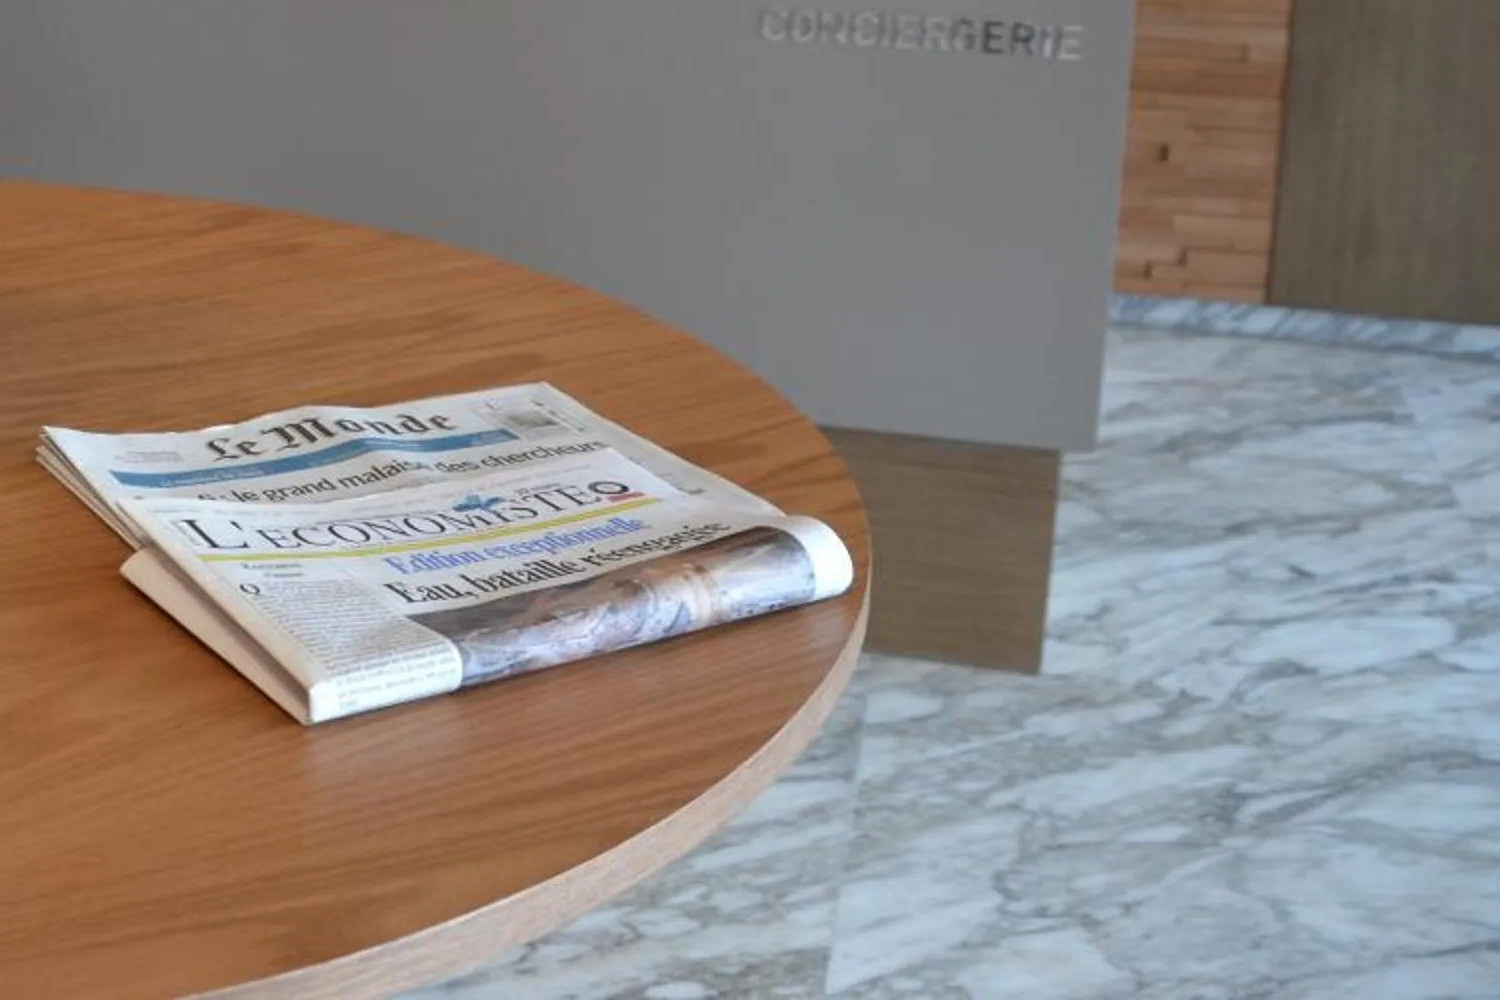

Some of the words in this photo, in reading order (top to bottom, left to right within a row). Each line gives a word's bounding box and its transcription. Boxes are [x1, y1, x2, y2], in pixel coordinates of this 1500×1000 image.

[760, 8, 1084, 61] CONCIERGERIE
[206, 436, 264, 462] Le
[260, 412, 458, 452] Monde
[261, 477, 336, 503] grand
